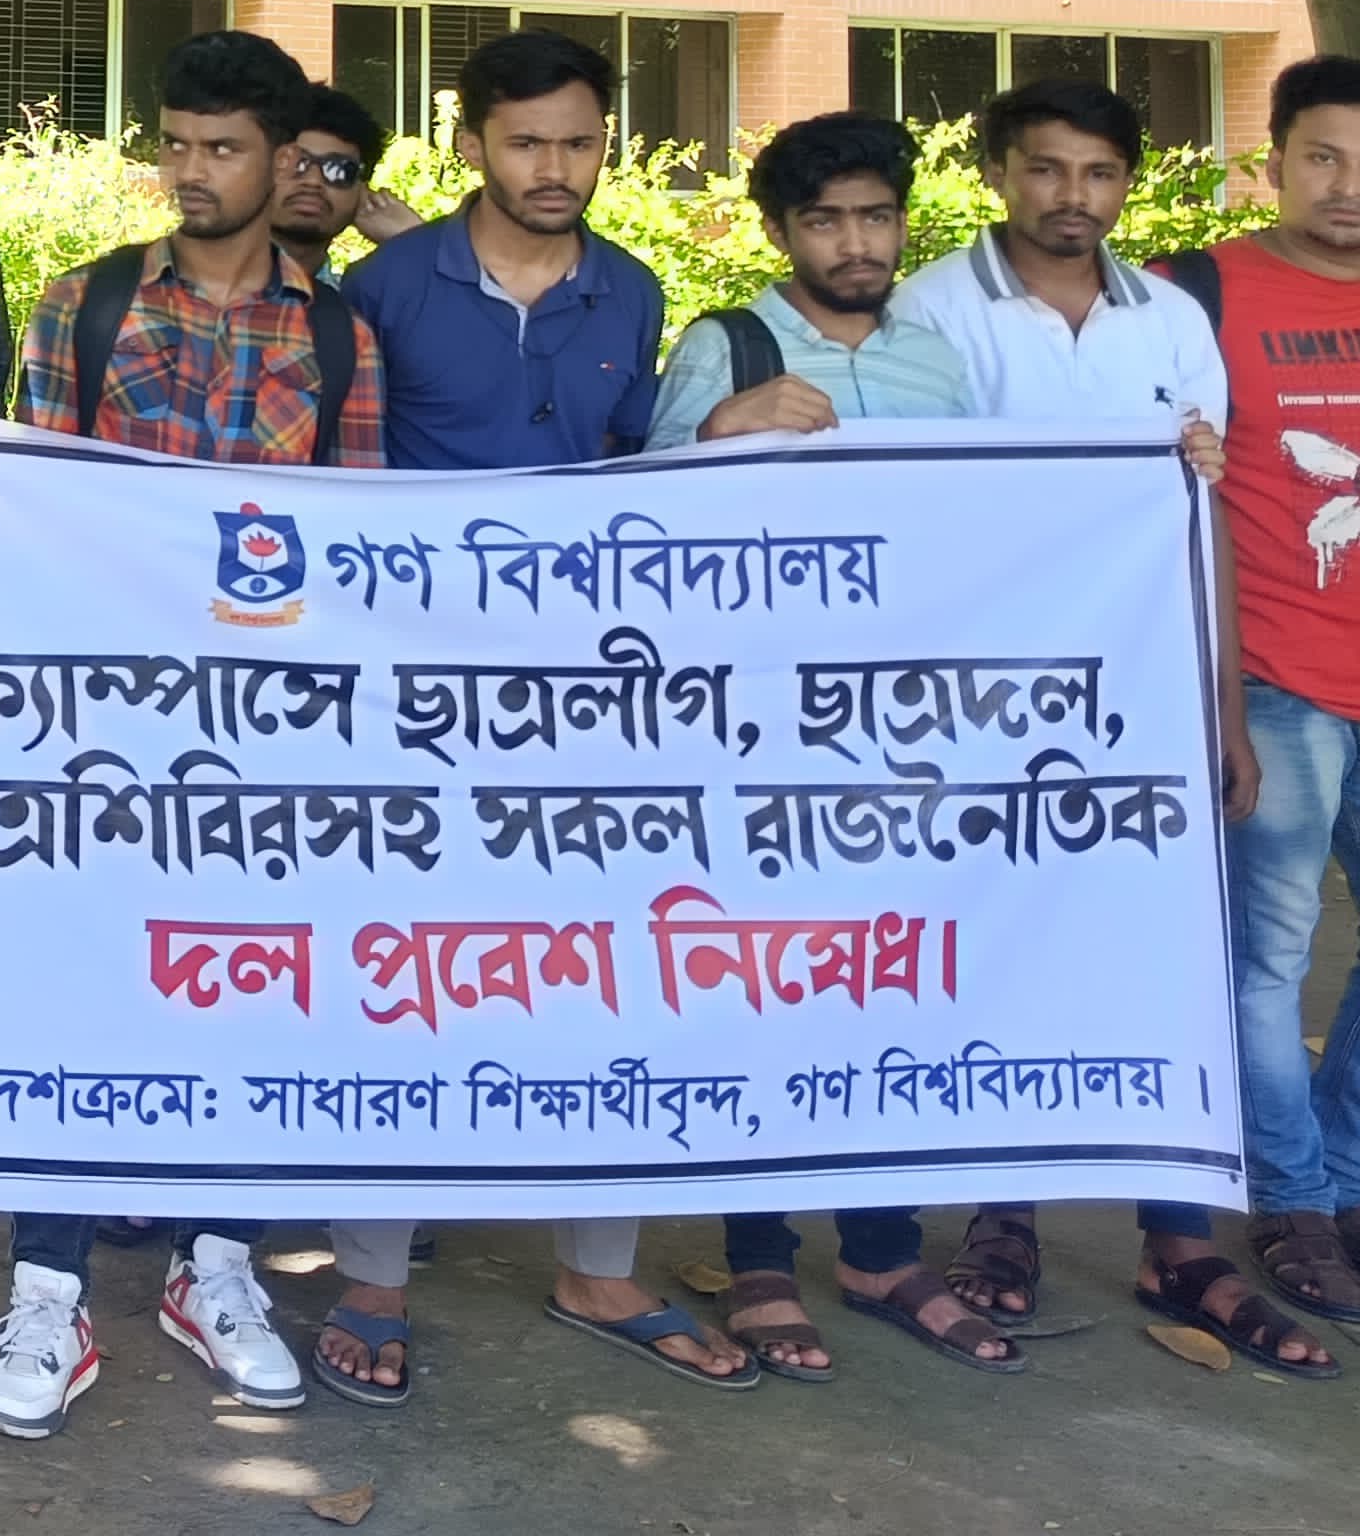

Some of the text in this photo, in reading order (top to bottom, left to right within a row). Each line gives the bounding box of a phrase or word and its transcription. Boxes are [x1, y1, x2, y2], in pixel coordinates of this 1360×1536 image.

[327, 513, 887, 614] গণ বিশ্ববিদ্যালয়
[393, 627, 762, 769] ছাত্রলীগ,
[797, 657, 1125, 767] ছাত্রদল,
[472, 786, 711, 875] সকল
[735, 747, 1188, 879] রাজনৈতিক
[145, 919, 314, 1017] দল
[351, 921, 619, 1036] প্রবেশ
[243, 1072, 450, 1132] সাধারণ
[786, 1064, 862, 1122] গণ
[874, 1041, 1170, 1117] বিশ্ববিদ্যালয়
